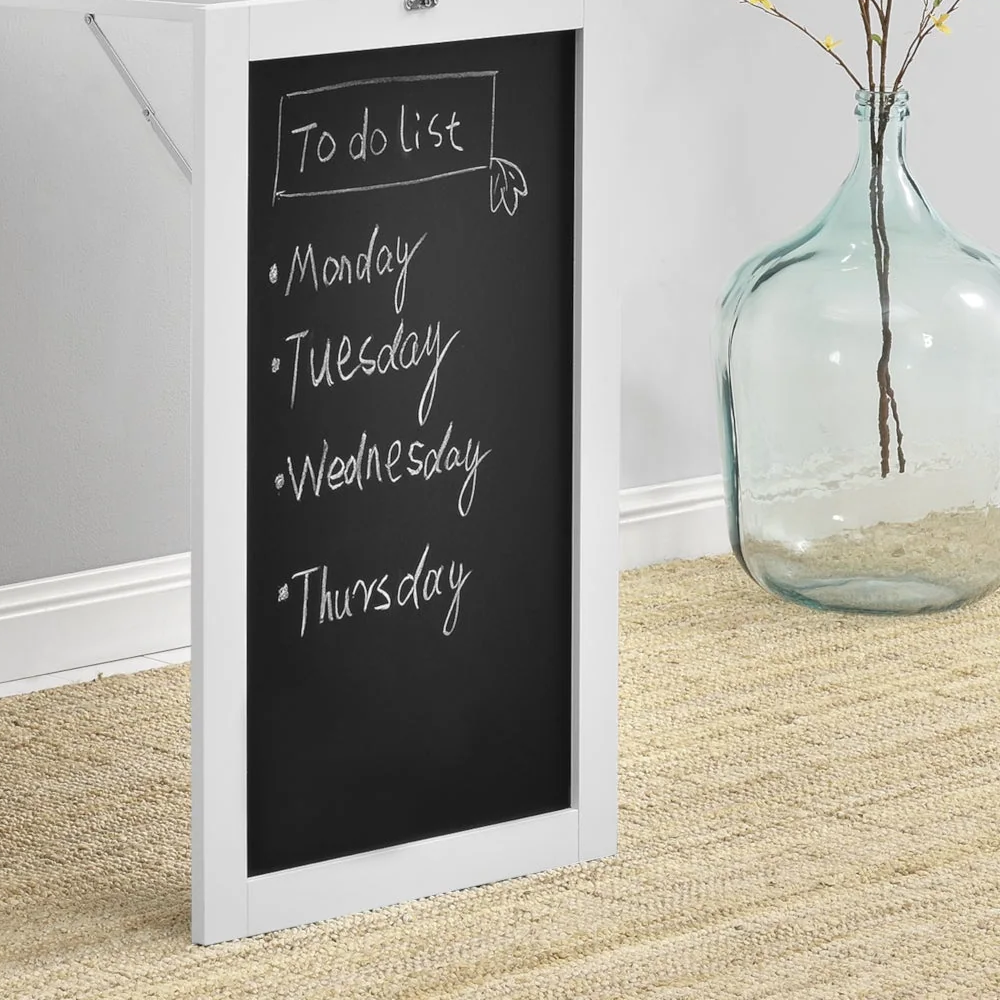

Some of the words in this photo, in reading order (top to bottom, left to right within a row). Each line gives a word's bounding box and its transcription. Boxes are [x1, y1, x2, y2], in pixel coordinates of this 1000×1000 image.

[291, 122, 337, 173] To
[348, 107, 388, 161] do
[399, 104, 464, 153] list
[284, 224, 427, 314] Monday
[285, 318, 461, 426] Tuesday
[286, 421, 492, 517] Wednesday
[291, 543, 472, 637] Thursday
